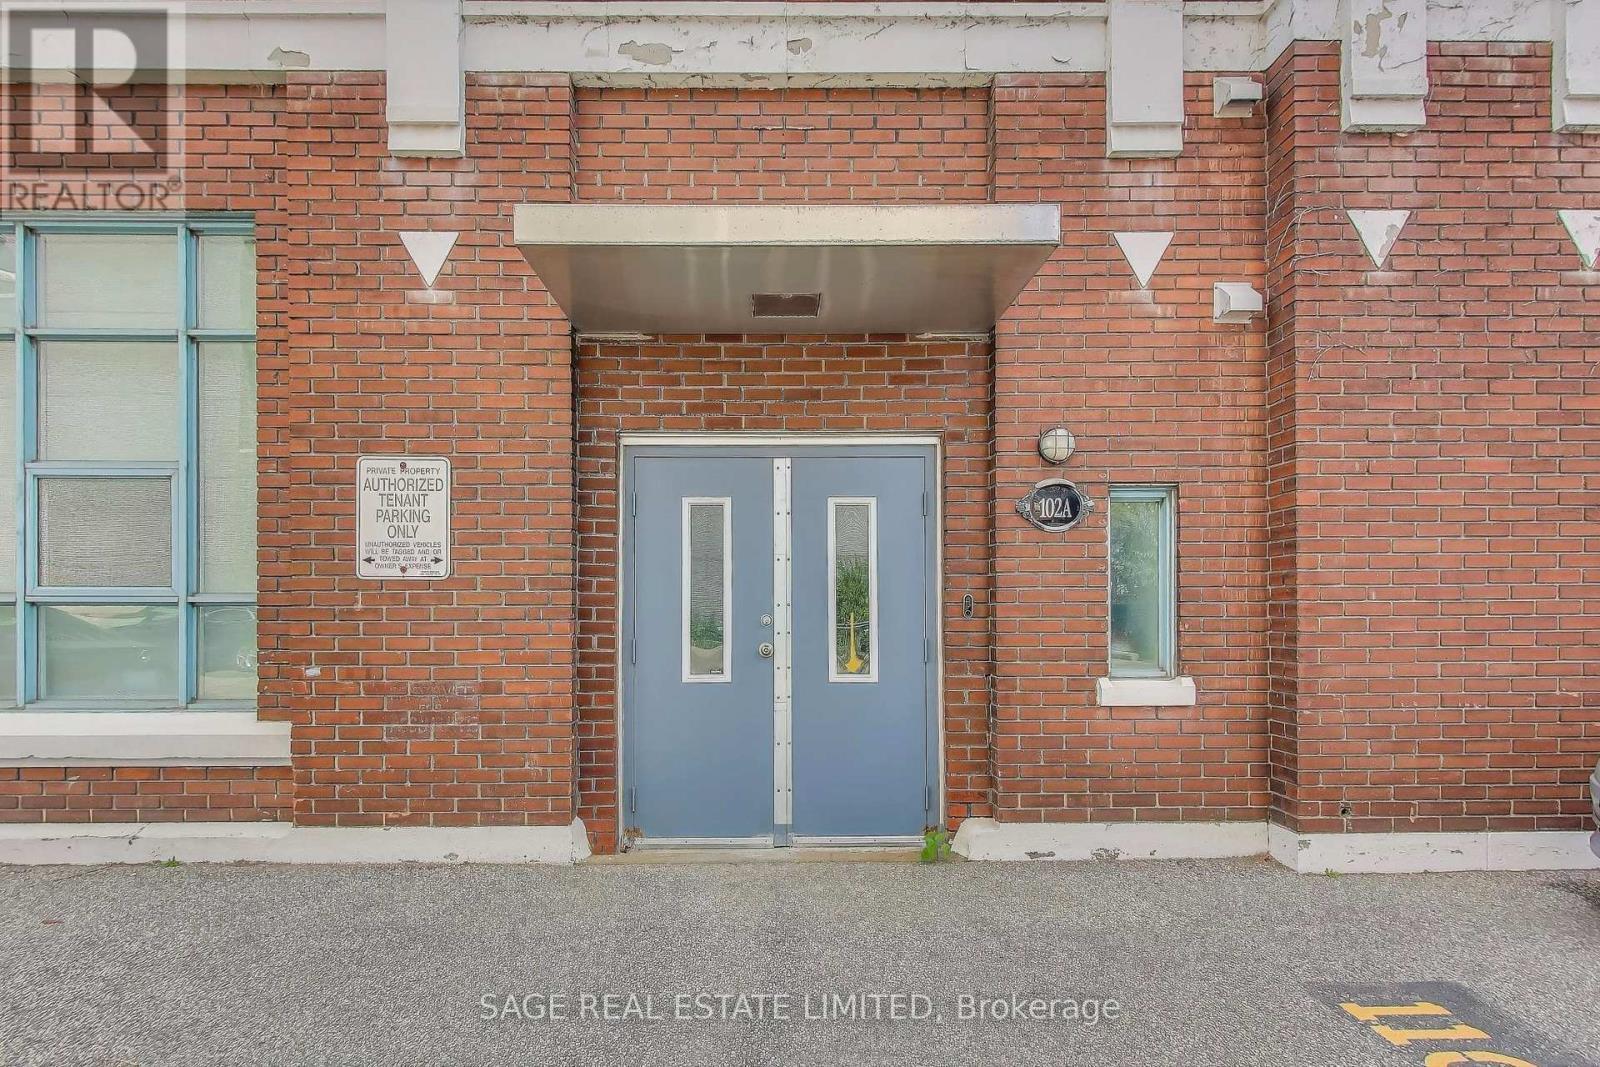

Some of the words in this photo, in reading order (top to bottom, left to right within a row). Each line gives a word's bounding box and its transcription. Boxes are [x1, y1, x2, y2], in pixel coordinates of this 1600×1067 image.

[366, 467, 396, 475] PRIVATE
[400, 467, 440, 475] PROPERTY
[363, 478, 444, 492] AUTHORIZED
[379, 493, 429, 507] TENANT
[1039, 497, 1072, 518] 102A
[376, 509, 431, 523] PARKING
[387, 525, 419, 539] ONLY
